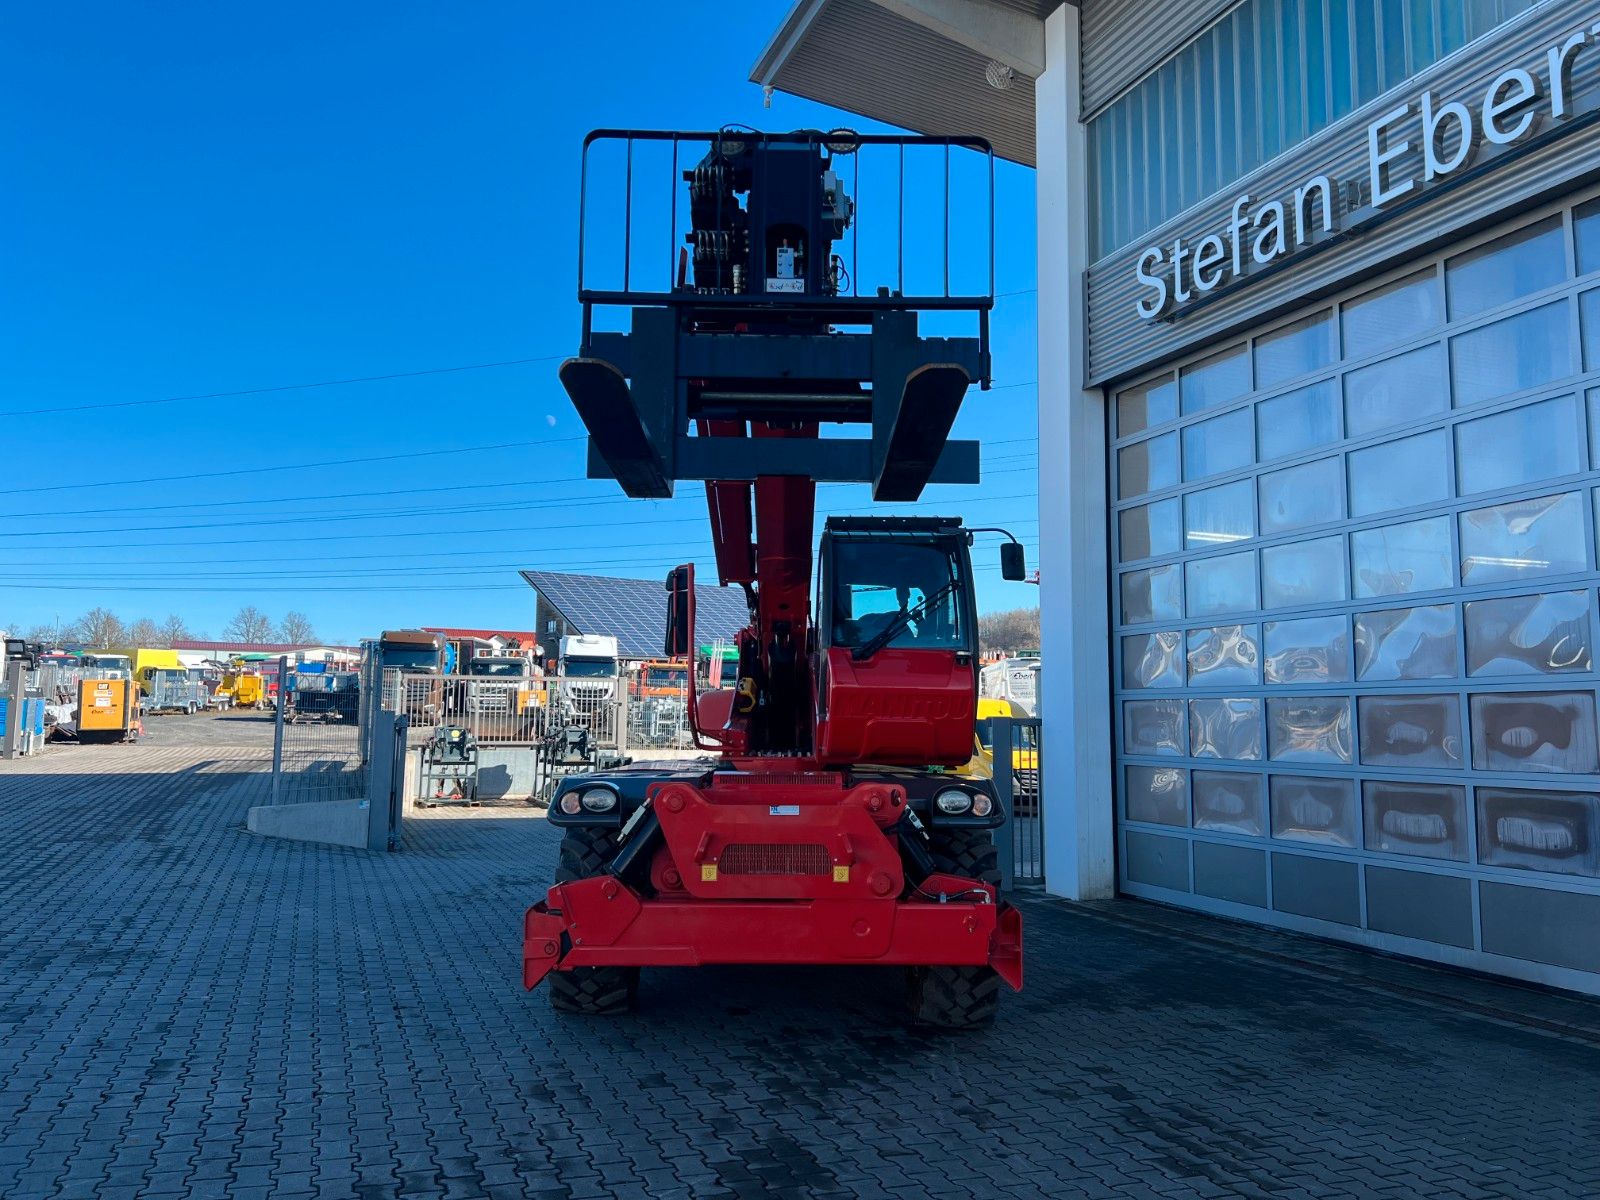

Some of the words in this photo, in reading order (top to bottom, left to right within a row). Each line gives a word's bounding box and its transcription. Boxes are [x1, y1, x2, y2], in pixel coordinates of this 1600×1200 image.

[1135, 175, 1337, 320] Stefan
[1368, 22, 1600, 208] Eber
[834, 694, 970, 719] MANITOU
